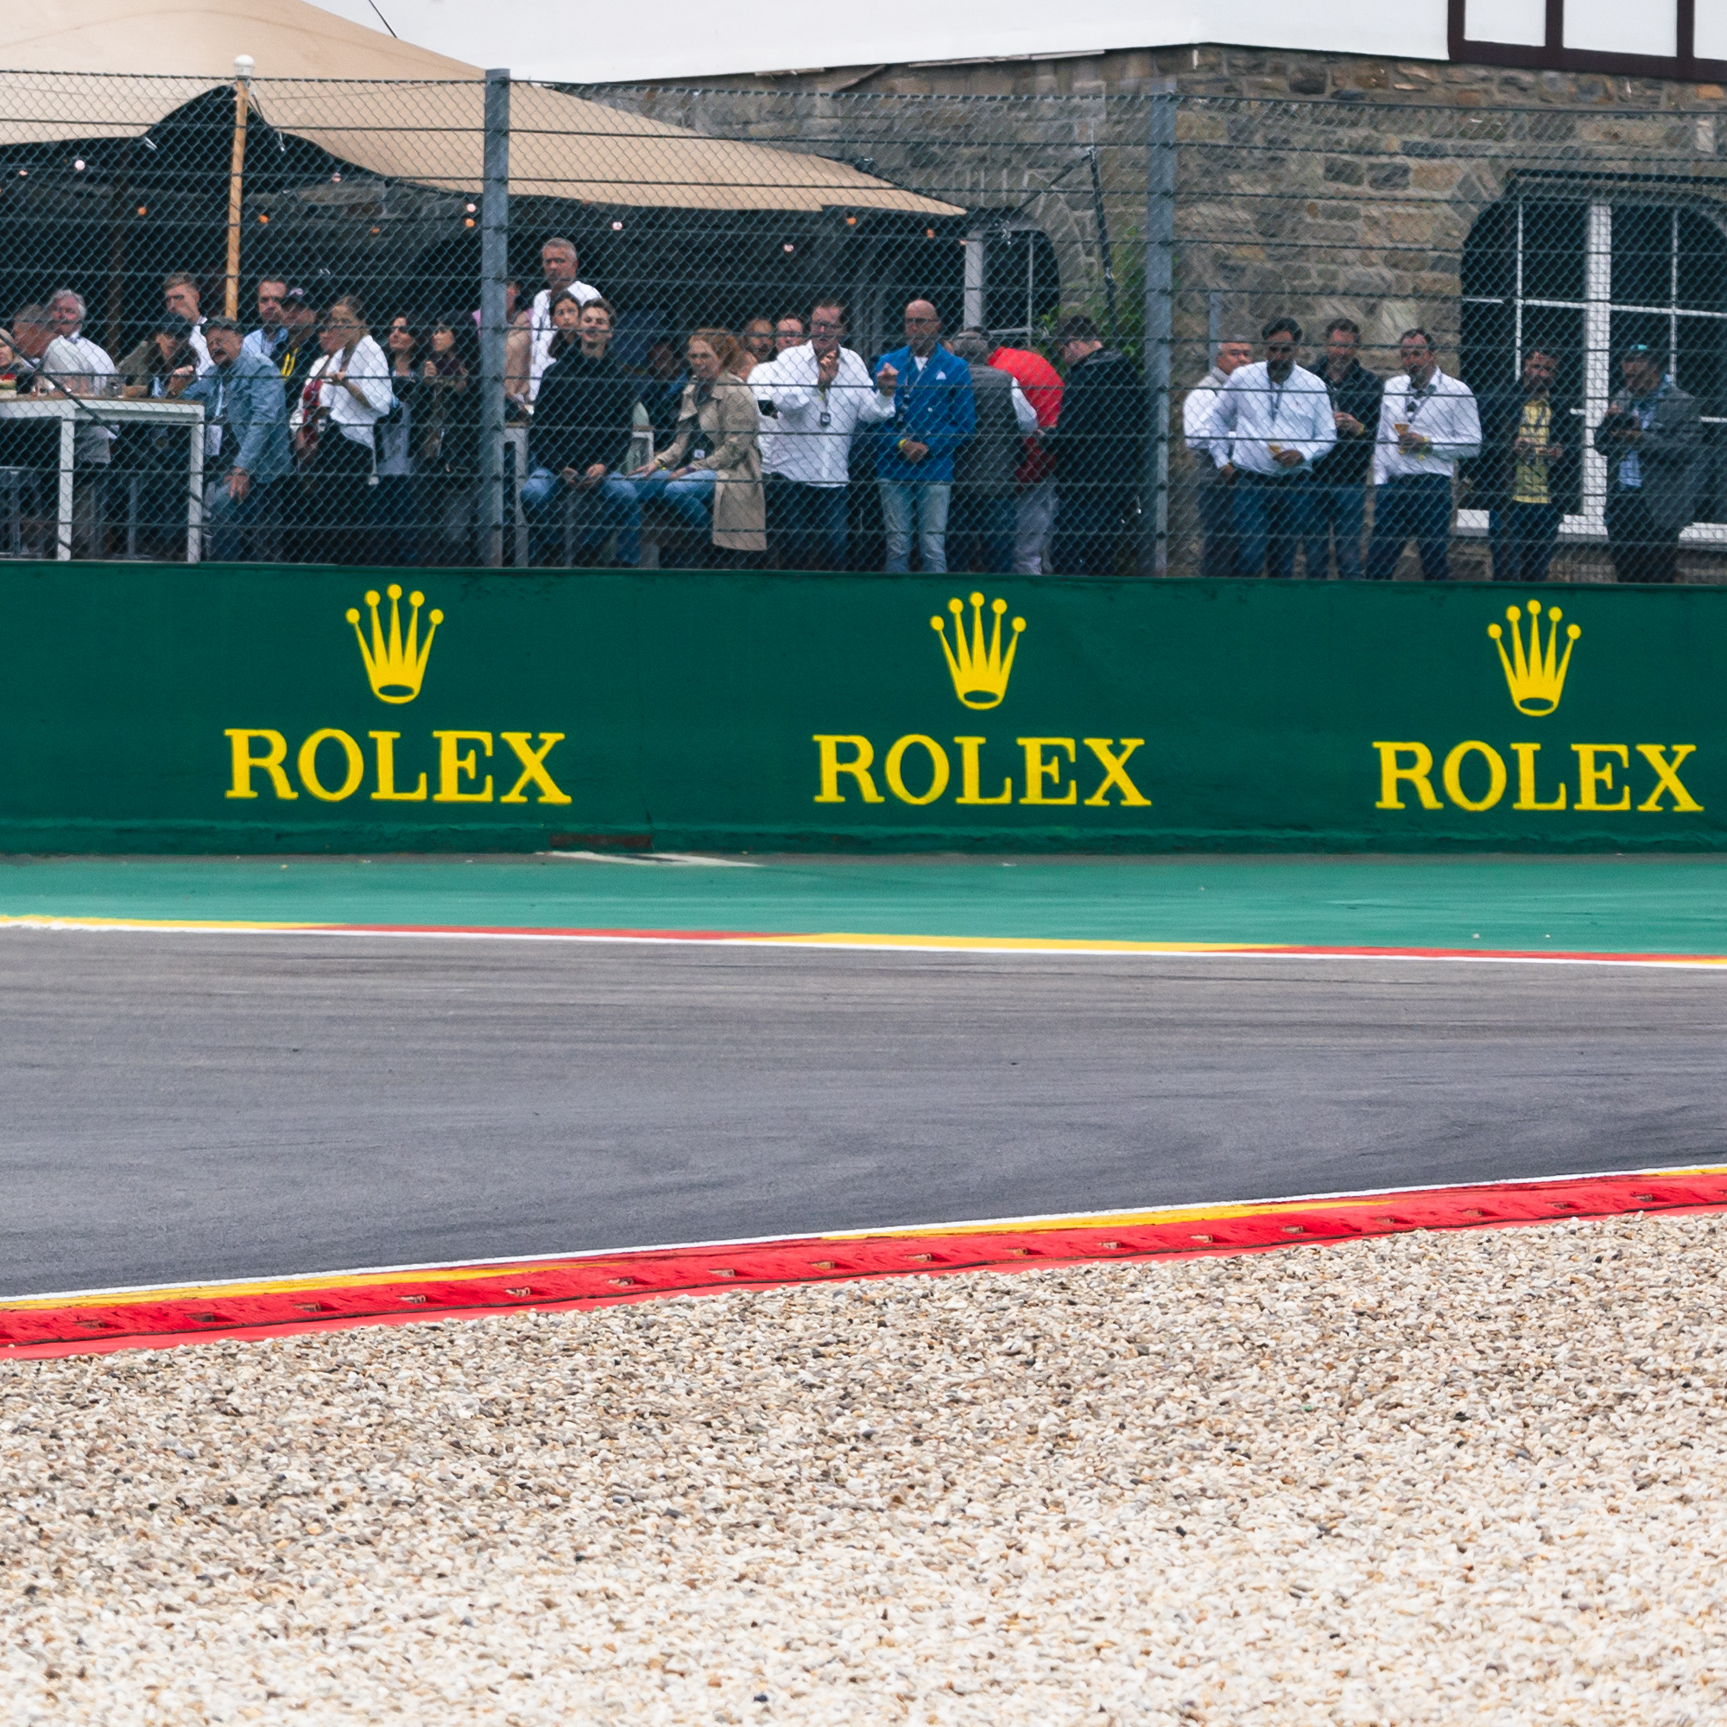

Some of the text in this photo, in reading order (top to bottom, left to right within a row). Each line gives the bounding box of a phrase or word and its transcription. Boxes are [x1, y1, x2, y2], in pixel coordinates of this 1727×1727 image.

[224, 728, 572, 805] ROLEX
[812, 733, 1152, 807] ROLEX
[1372, 740, 1704, 812] ROLEX
